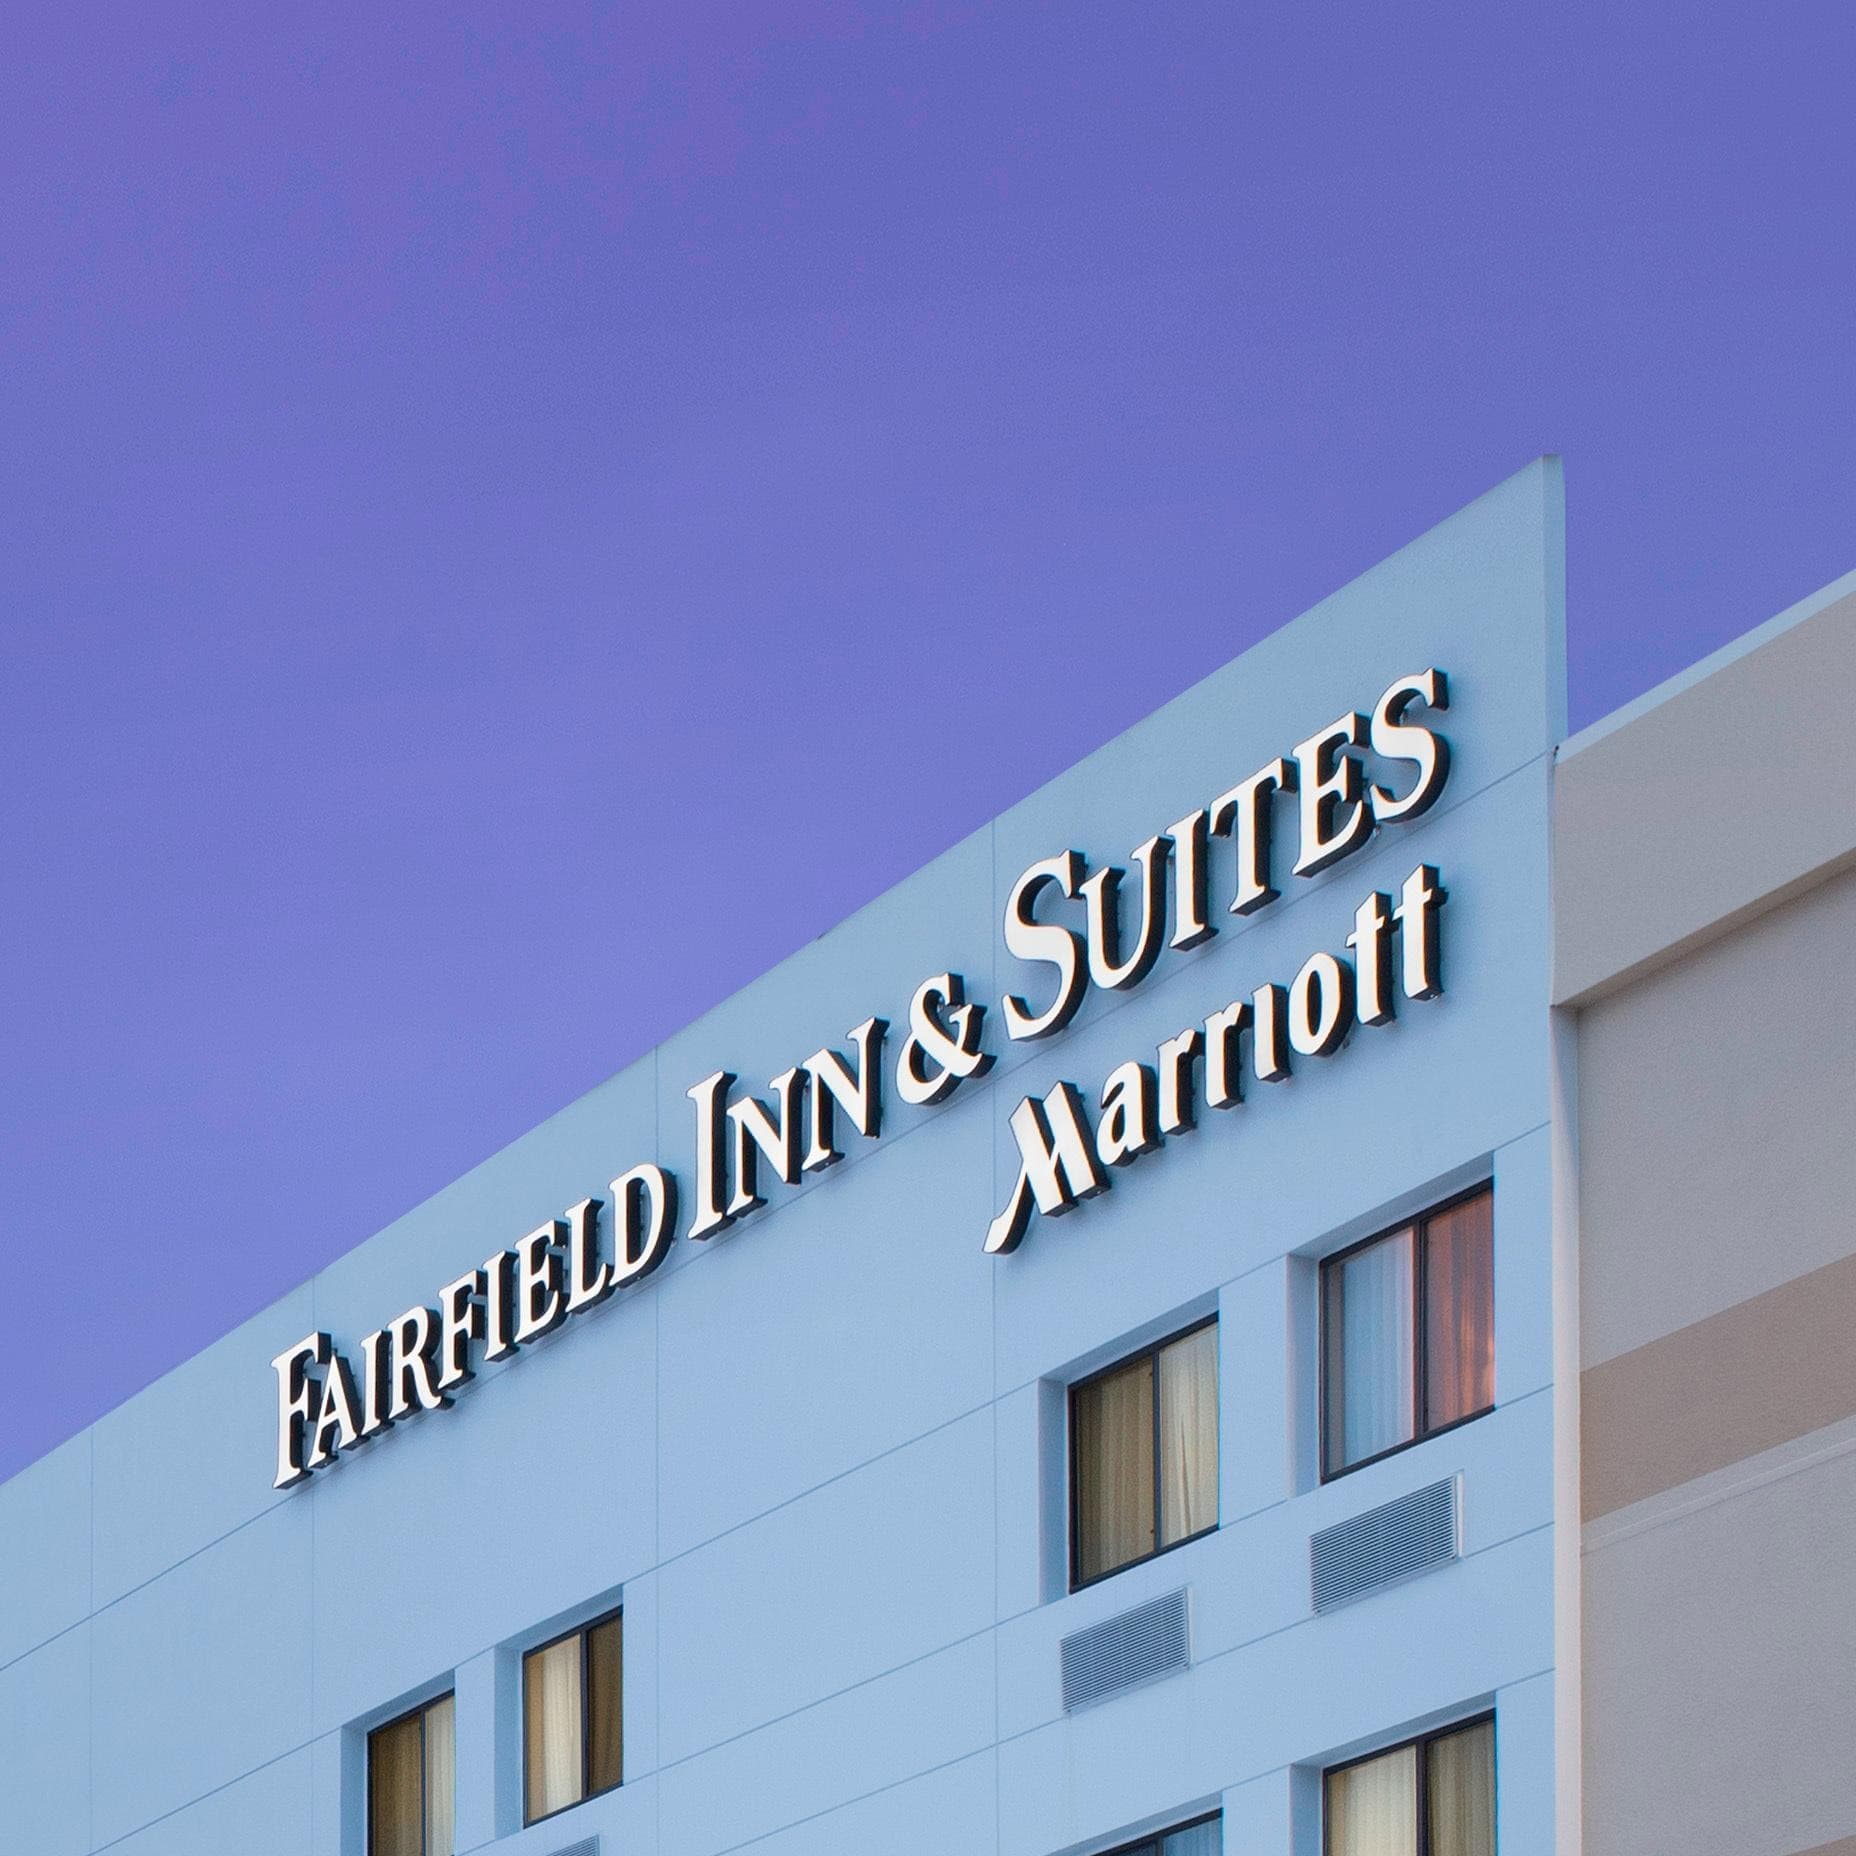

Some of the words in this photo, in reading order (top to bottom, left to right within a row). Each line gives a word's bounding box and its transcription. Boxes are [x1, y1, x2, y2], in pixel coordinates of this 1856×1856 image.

[271, 1162, 678, 1490] FAIRFIELD
[686, 1016, 891, 1240] INN
[895, 973, 997, 1106] &
[1001, 668, 1451, 1041] SUITES
[982, 863, 1448, 1255] Marriott
